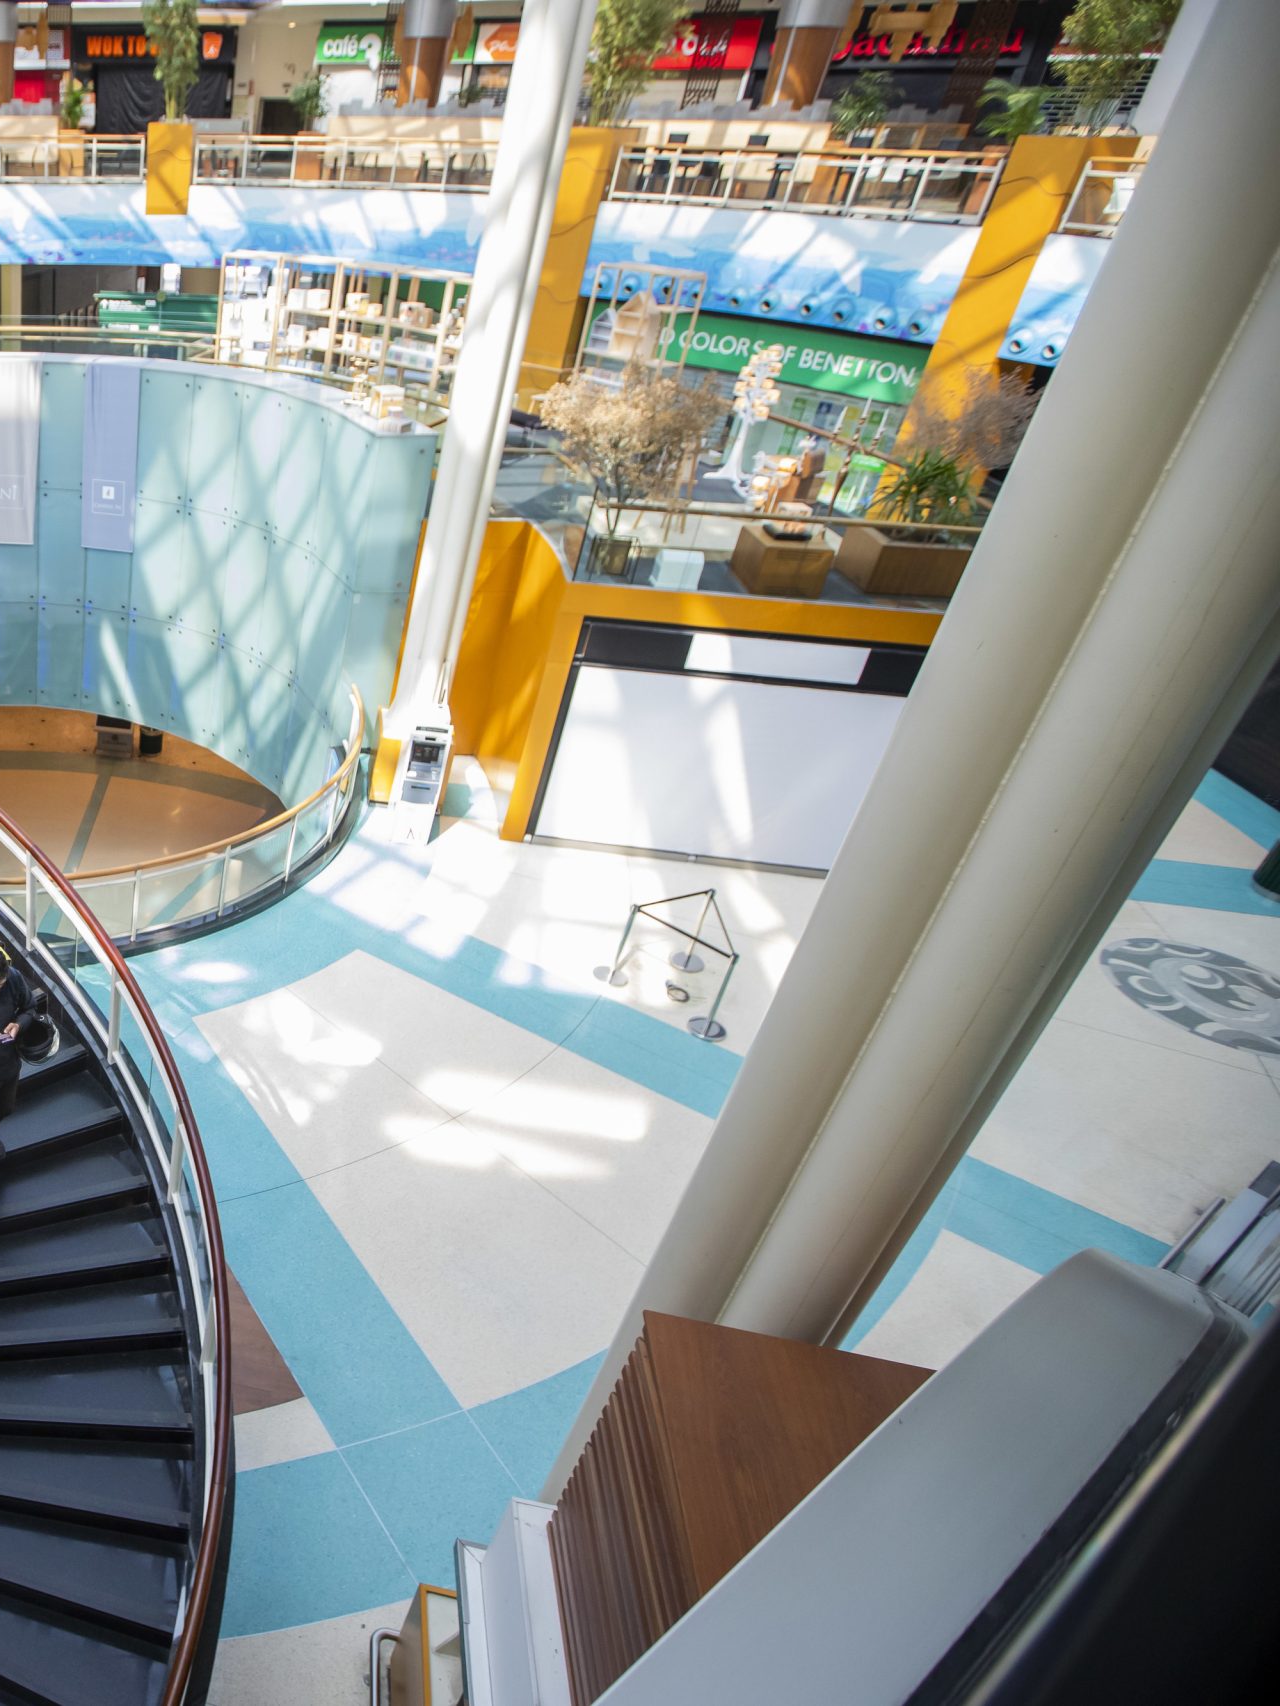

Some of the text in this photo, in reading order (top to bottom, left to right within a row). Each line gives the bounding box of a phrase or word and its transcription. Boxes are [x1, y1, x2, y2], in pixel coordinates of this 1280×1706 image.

[87, 35, 124, 57] WOK
[127, 35, 147, 57] TO
[678, 330, 764, 358] COLORS
